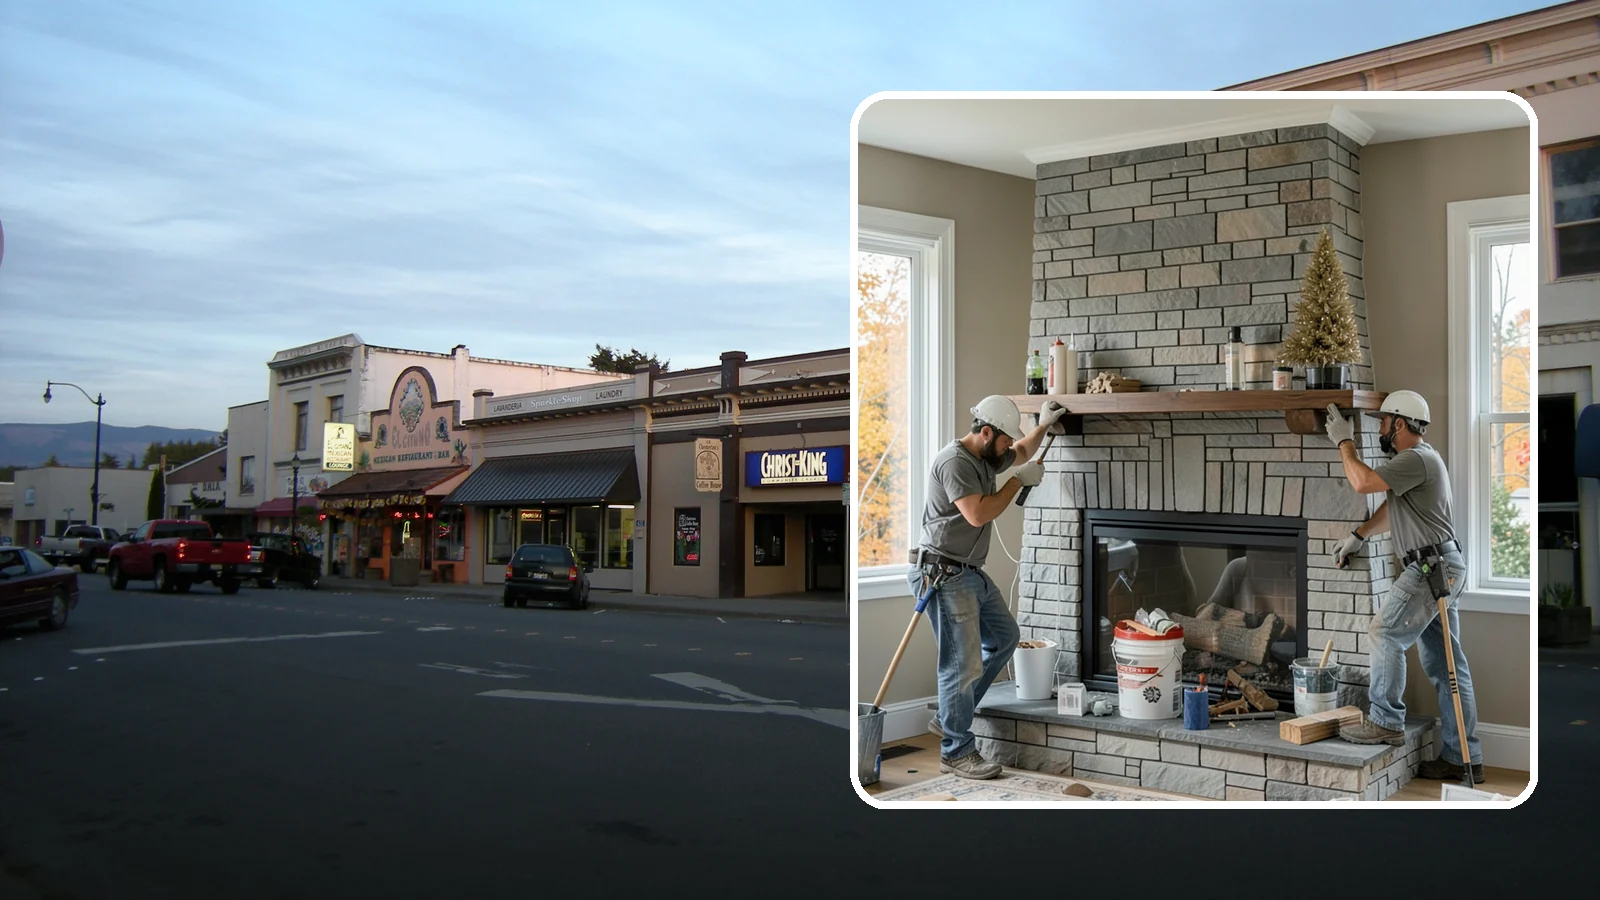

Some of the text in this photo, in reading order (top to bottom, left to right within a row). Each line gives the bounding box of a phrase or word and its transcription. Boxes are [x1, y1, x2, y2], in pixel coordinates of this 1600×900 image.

[595, 389, 623, 400] LAUNDRY
[493, 402, 522, 413] LAVANDERIA
[530, 395, 582, 409] Sparkle Shop
[373, 455, 396, 464] MEXICAN
[397, 451, 433, 462] RESTAURANT
[438, 450, 450, 459] BAR
[761, 450, 827, 478] CHRIST KING
